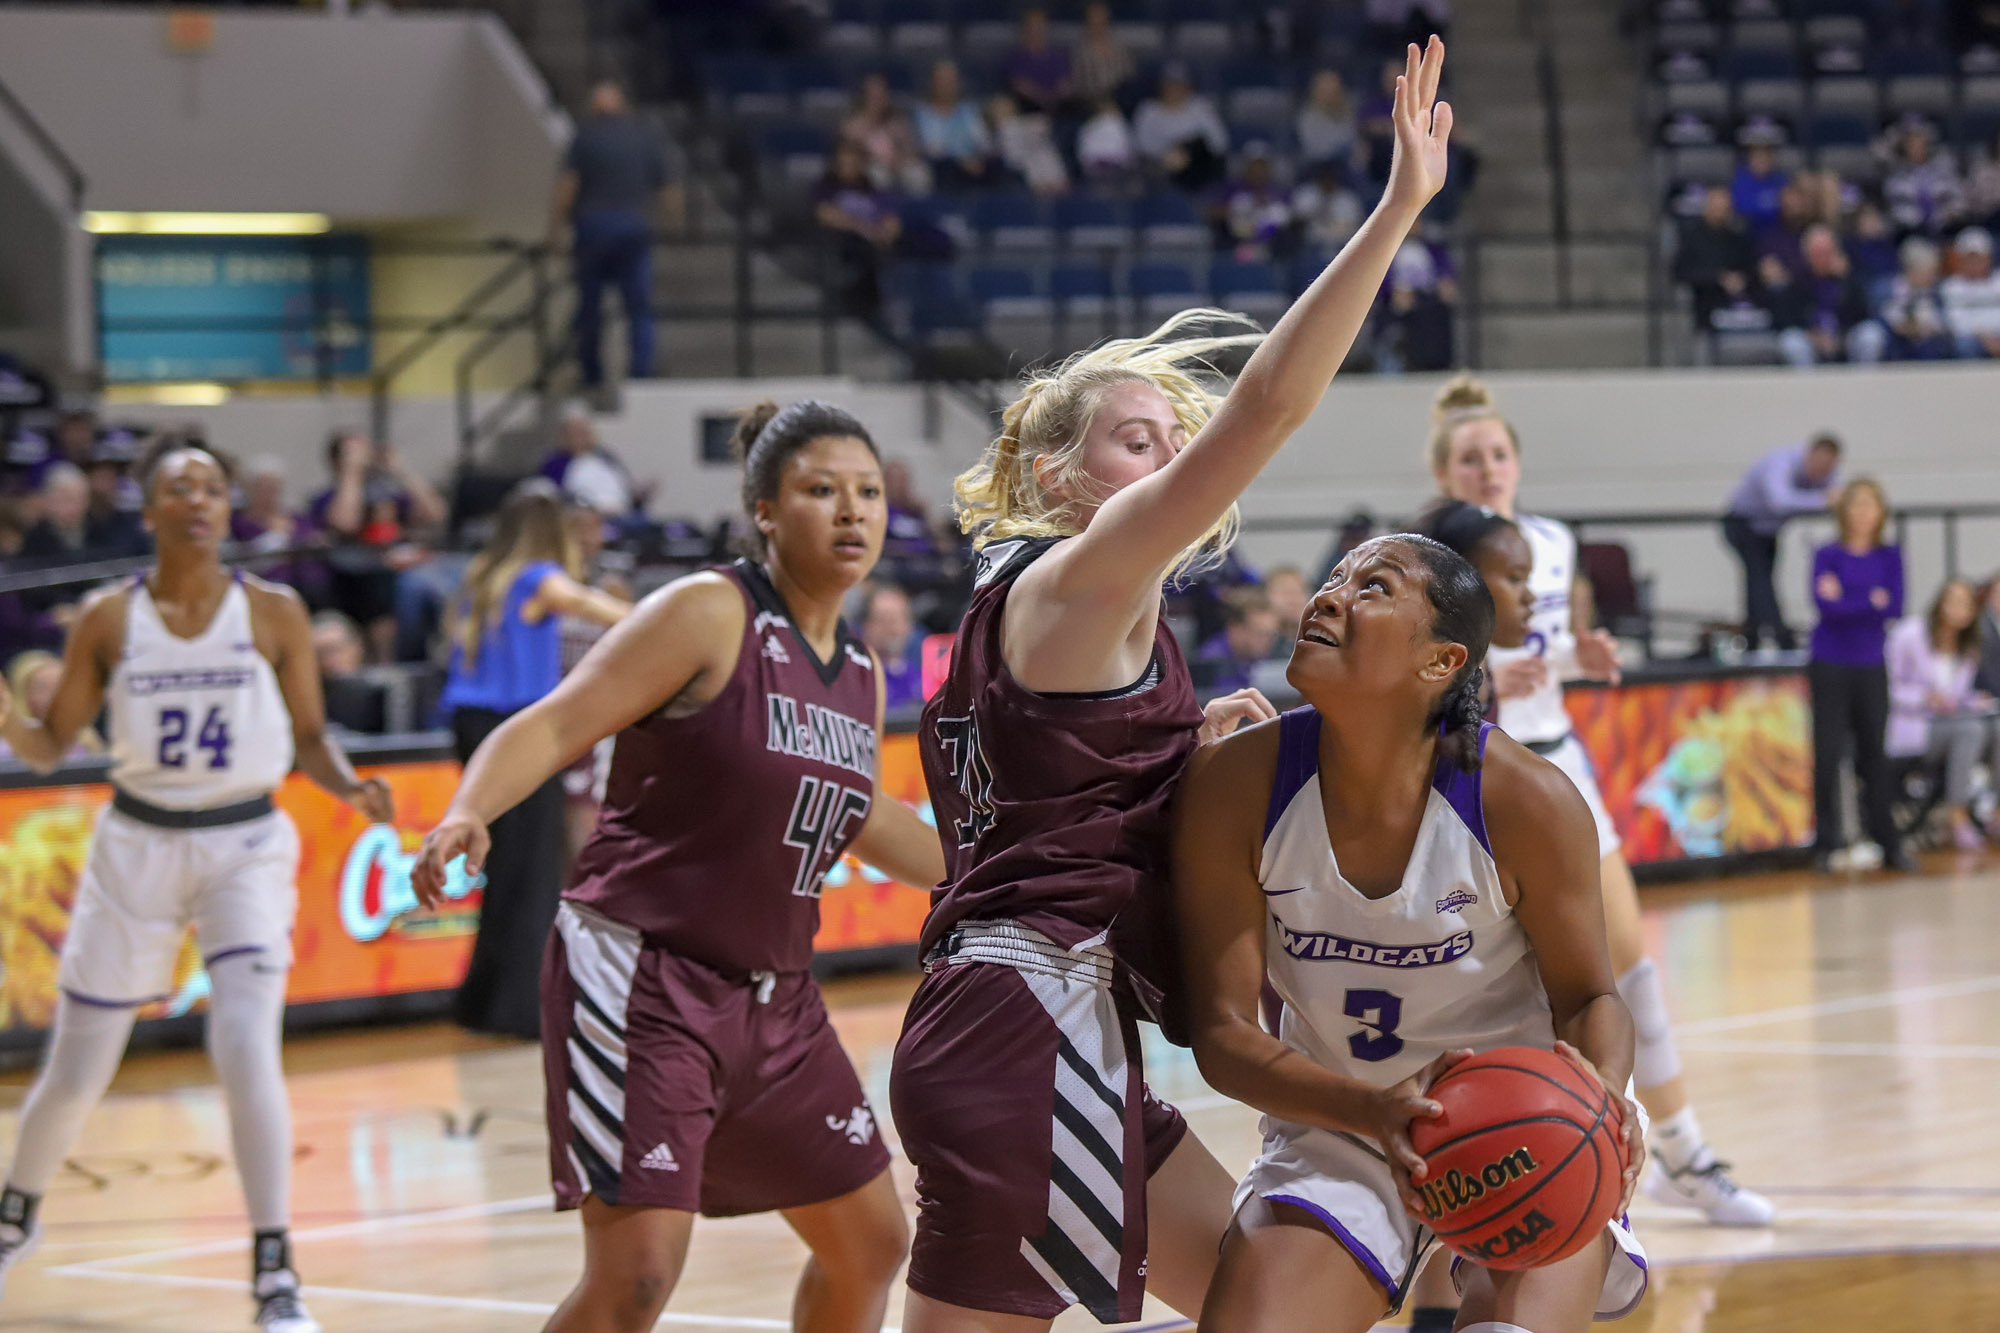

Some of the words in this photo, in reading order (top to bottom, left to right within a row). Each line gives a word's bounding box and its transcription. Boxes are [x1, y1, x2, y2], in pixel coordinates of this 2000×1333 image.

[158, 704, 233, 769] 24
[782, 775, 871, 899] 45
[1274, 920, 1473, 968] WILDCATS
[1343, 987, 1405, 1062] 3
[1457, 1207, 1556, 1261] NCAA
